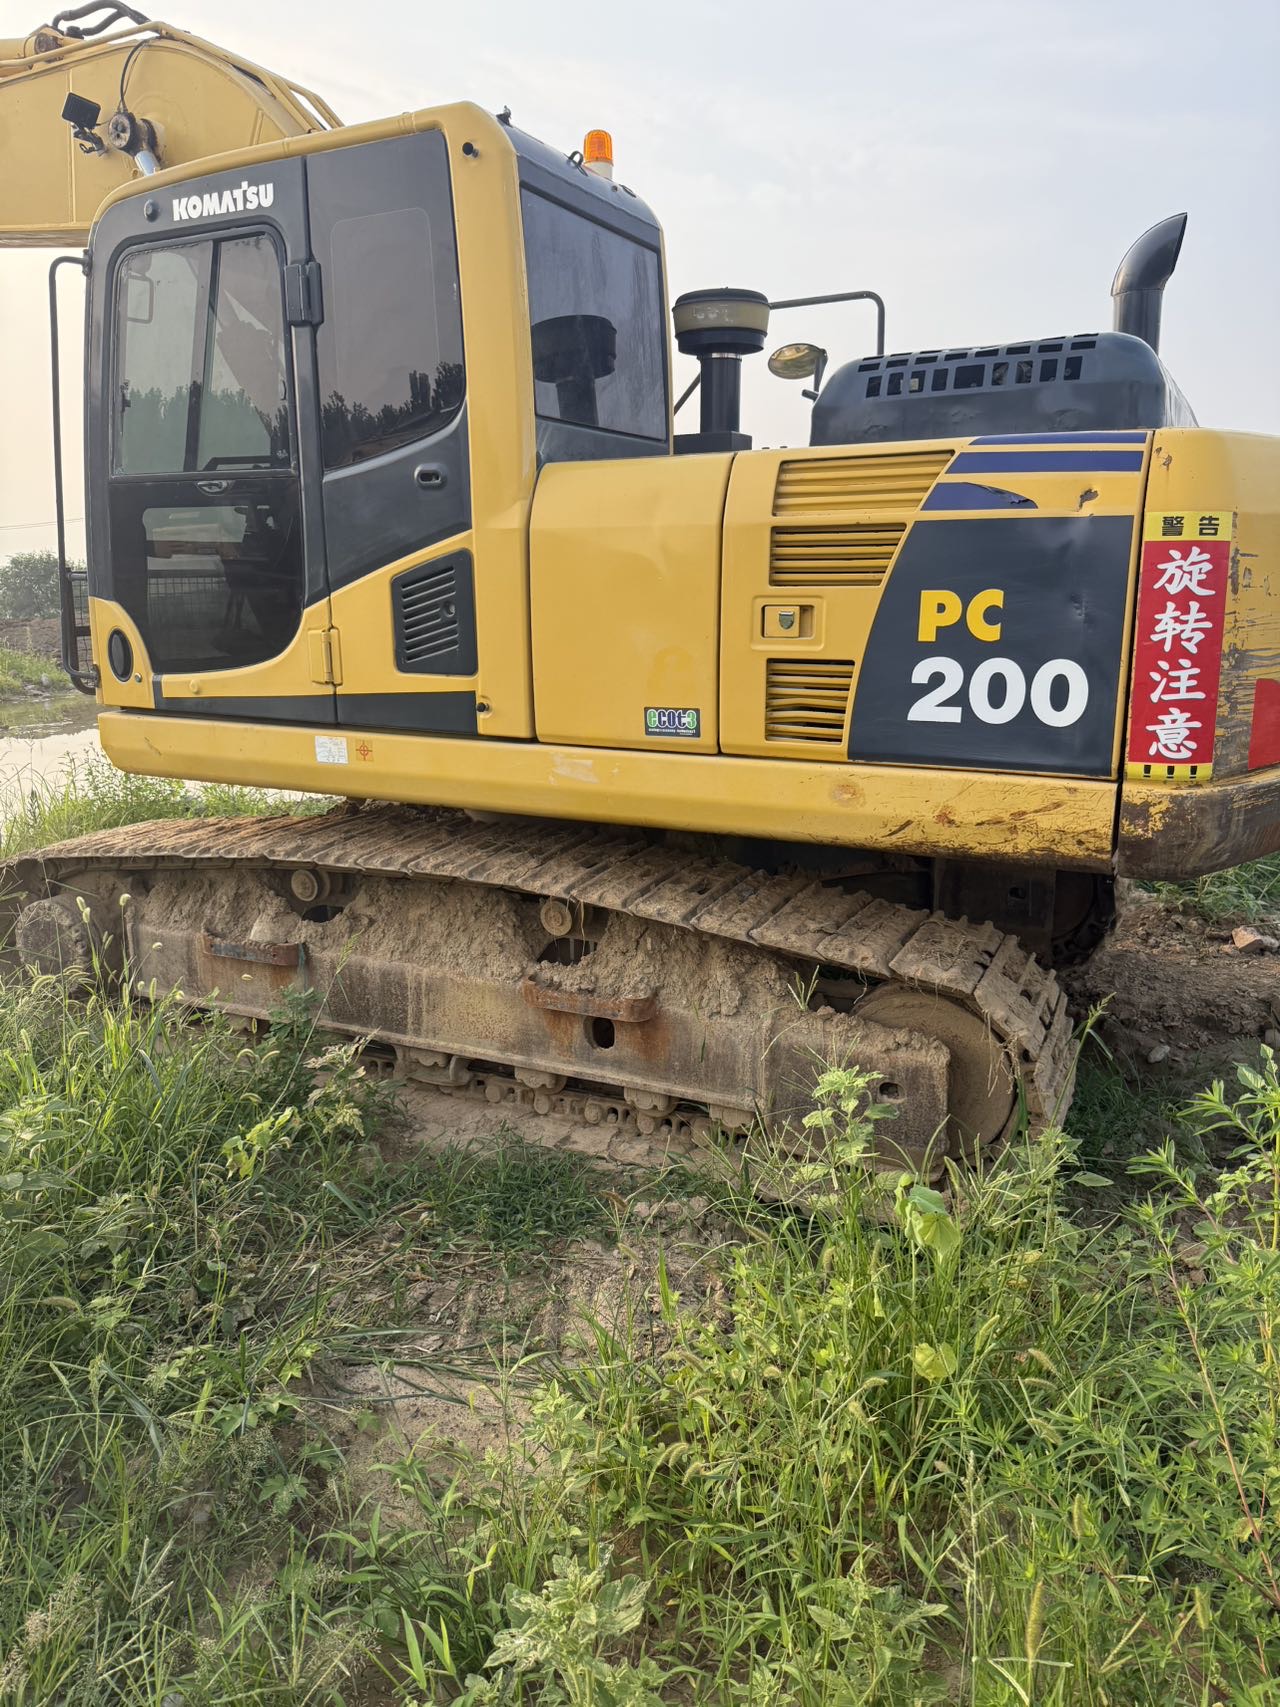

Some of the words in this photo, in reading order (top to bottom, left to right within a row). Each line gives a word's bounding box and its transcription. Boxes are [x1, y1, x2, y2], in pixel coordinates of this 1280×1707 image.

[172, 181, 274, 221] KOMATSU
[1161, 516, 1220, 537] 警告
[917, 588, 1005, 643] PC
[1145, 546, 1216, 760] 旋转注意
[907, 656, 1089, 728] 200
[647, 709, 697, 729] ecot3
